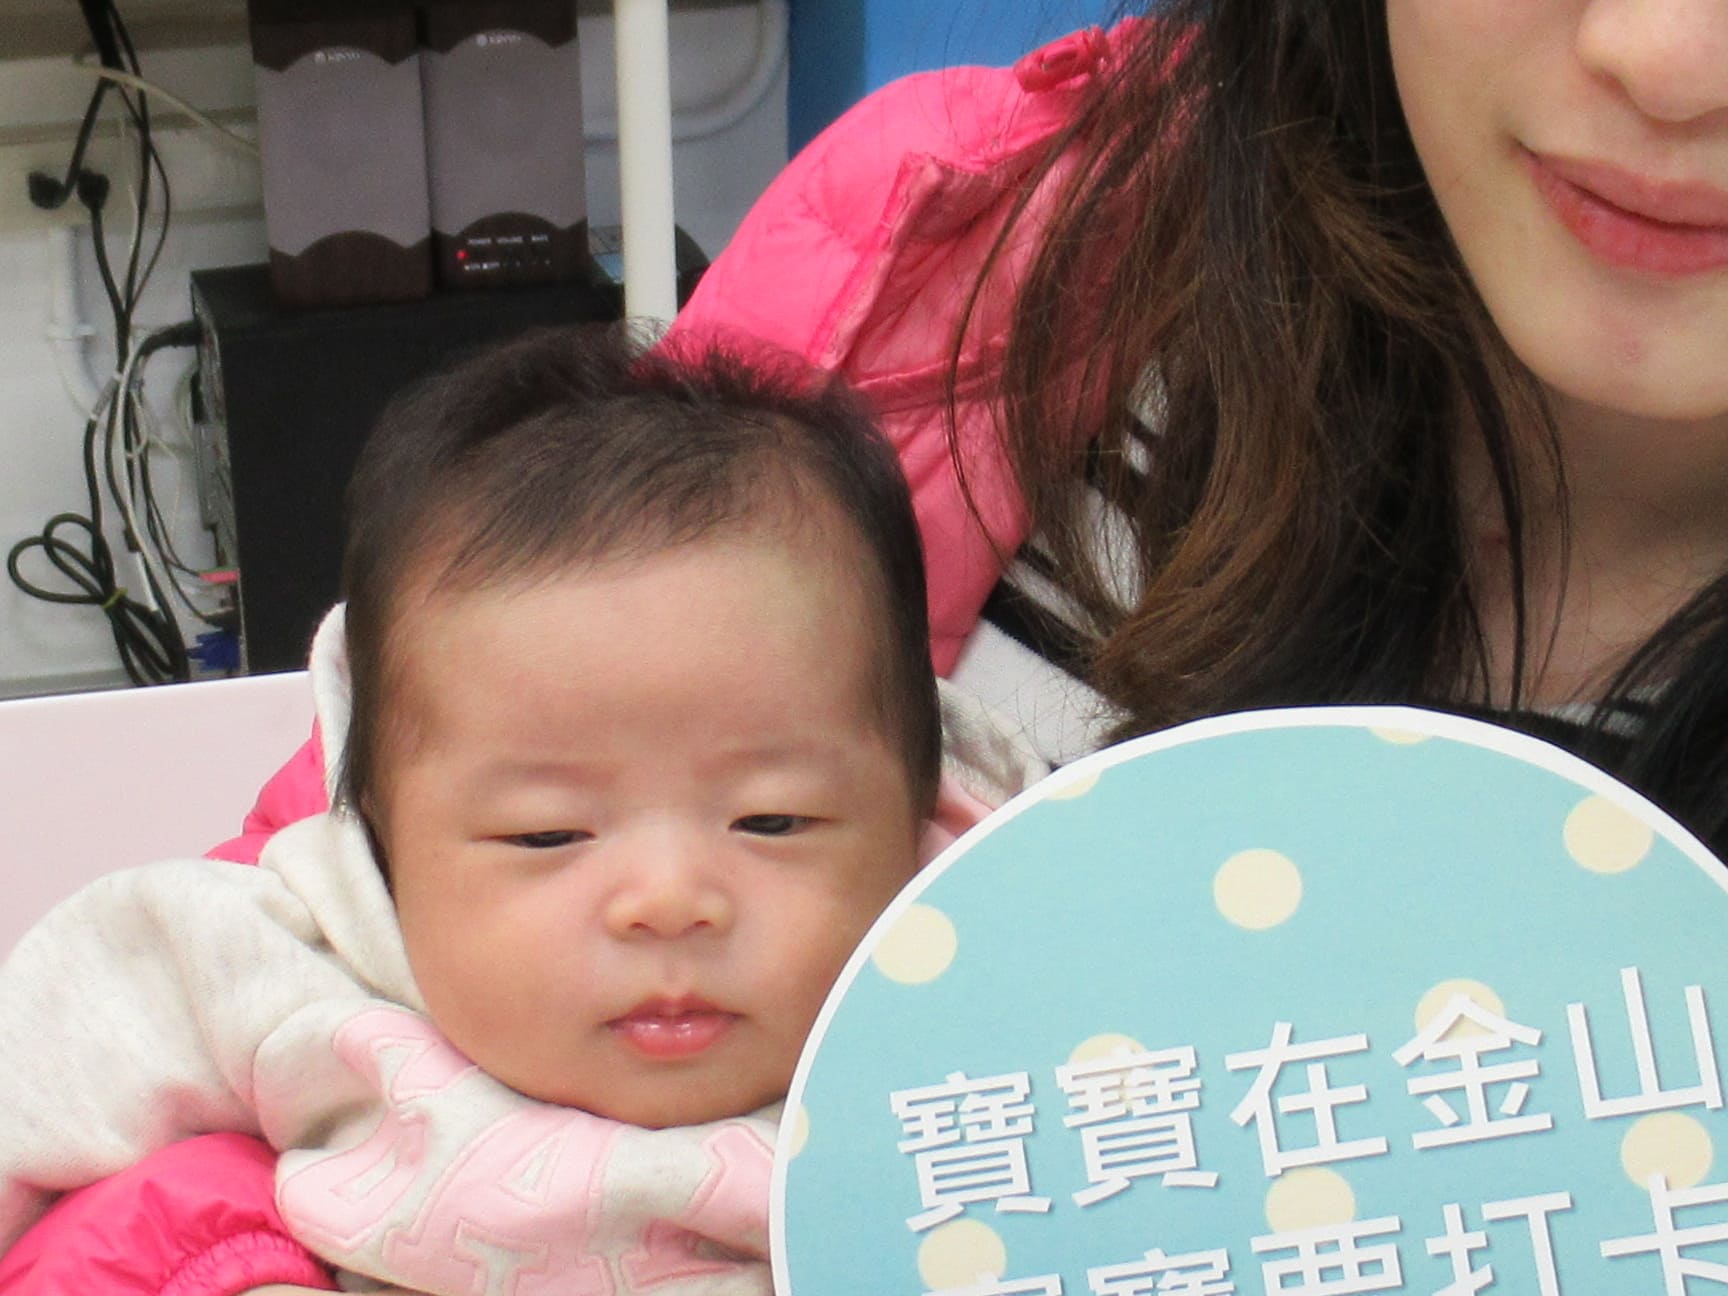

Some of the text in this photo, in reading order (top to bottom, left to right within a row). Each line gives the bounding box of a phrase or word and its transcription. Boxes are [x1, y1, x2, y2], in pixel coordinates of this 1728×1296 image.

[891, 966, 1725, 1230] 寶寶在金山
